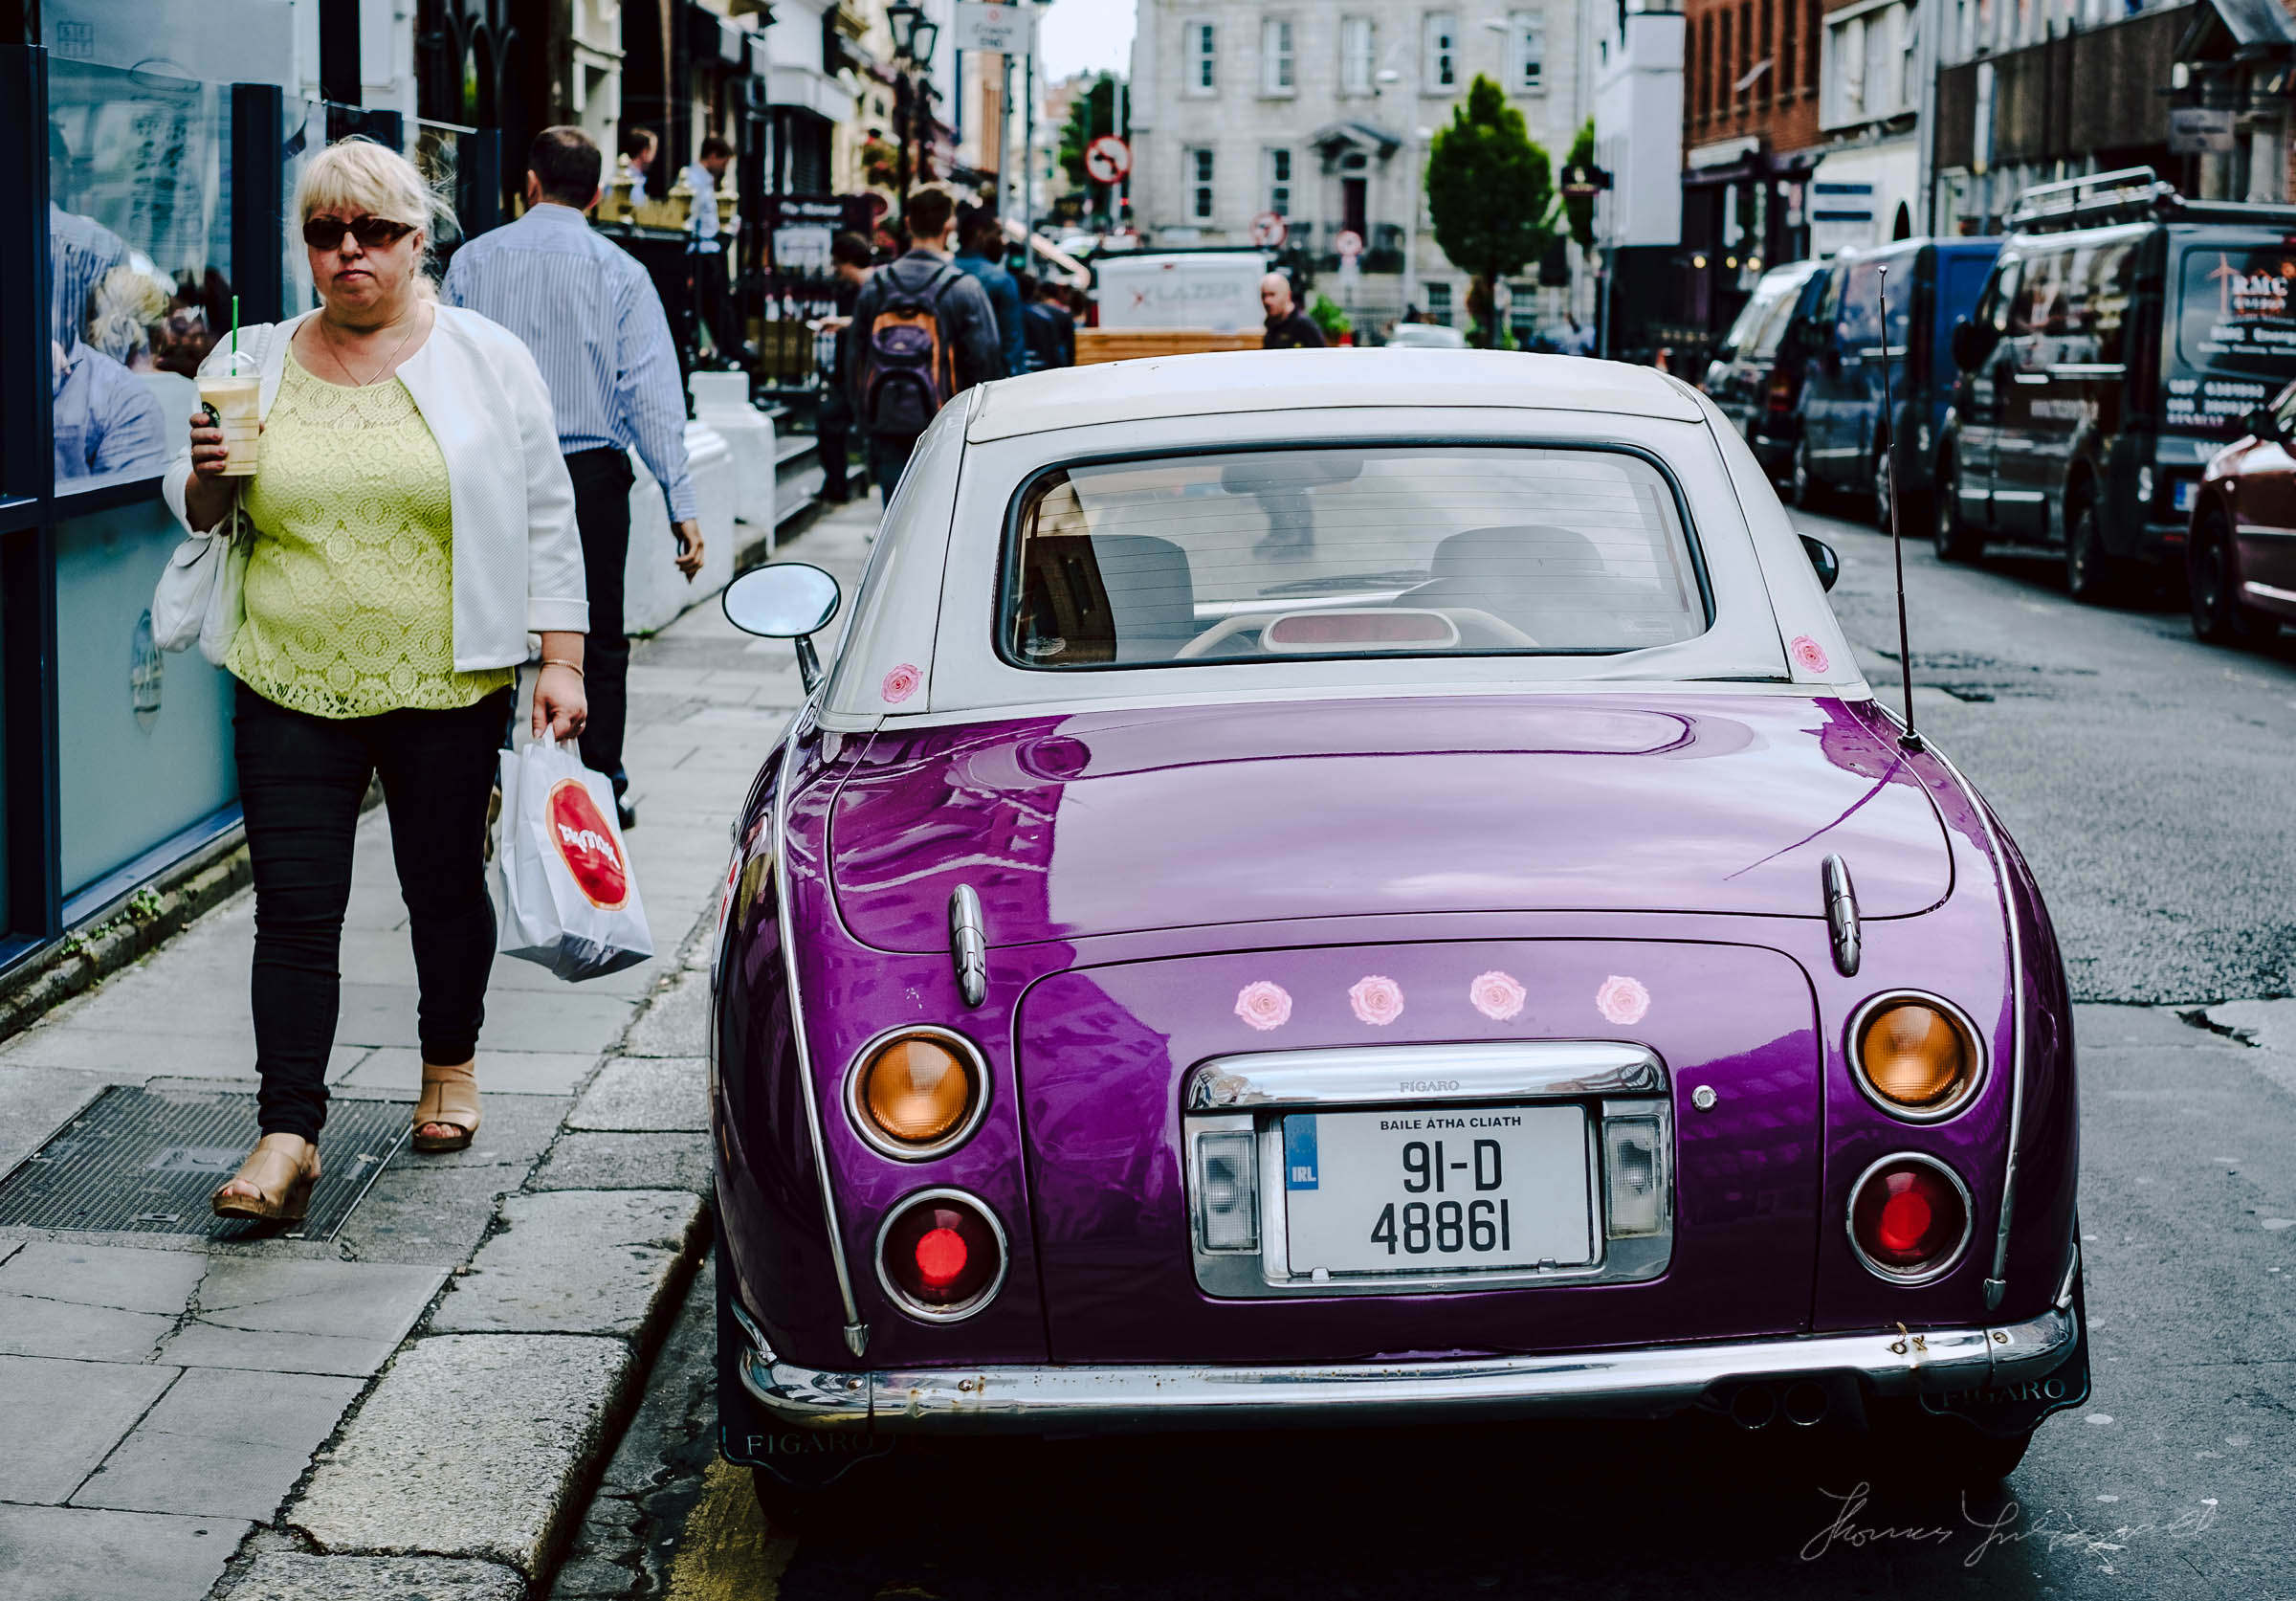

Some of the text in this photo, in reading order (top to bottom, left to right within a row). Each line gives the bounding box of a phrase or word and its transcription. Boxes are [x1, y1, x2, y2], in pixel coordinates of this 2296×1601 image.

[1400, 1079, 1461, 1094] FIGARO
[1380, 1116, 1522, 1131] BAILE ÁTHA CLIATH
[1292, 1166, 1317, 1183] IRL
[1402, 1139, 1502, 1193] 91-D
[1371, 1198, 1511, 1256] 48861
[1943, 1378, 2065, 1408] FIGARO
[746, 1433, 873, 1456] FIGARO
